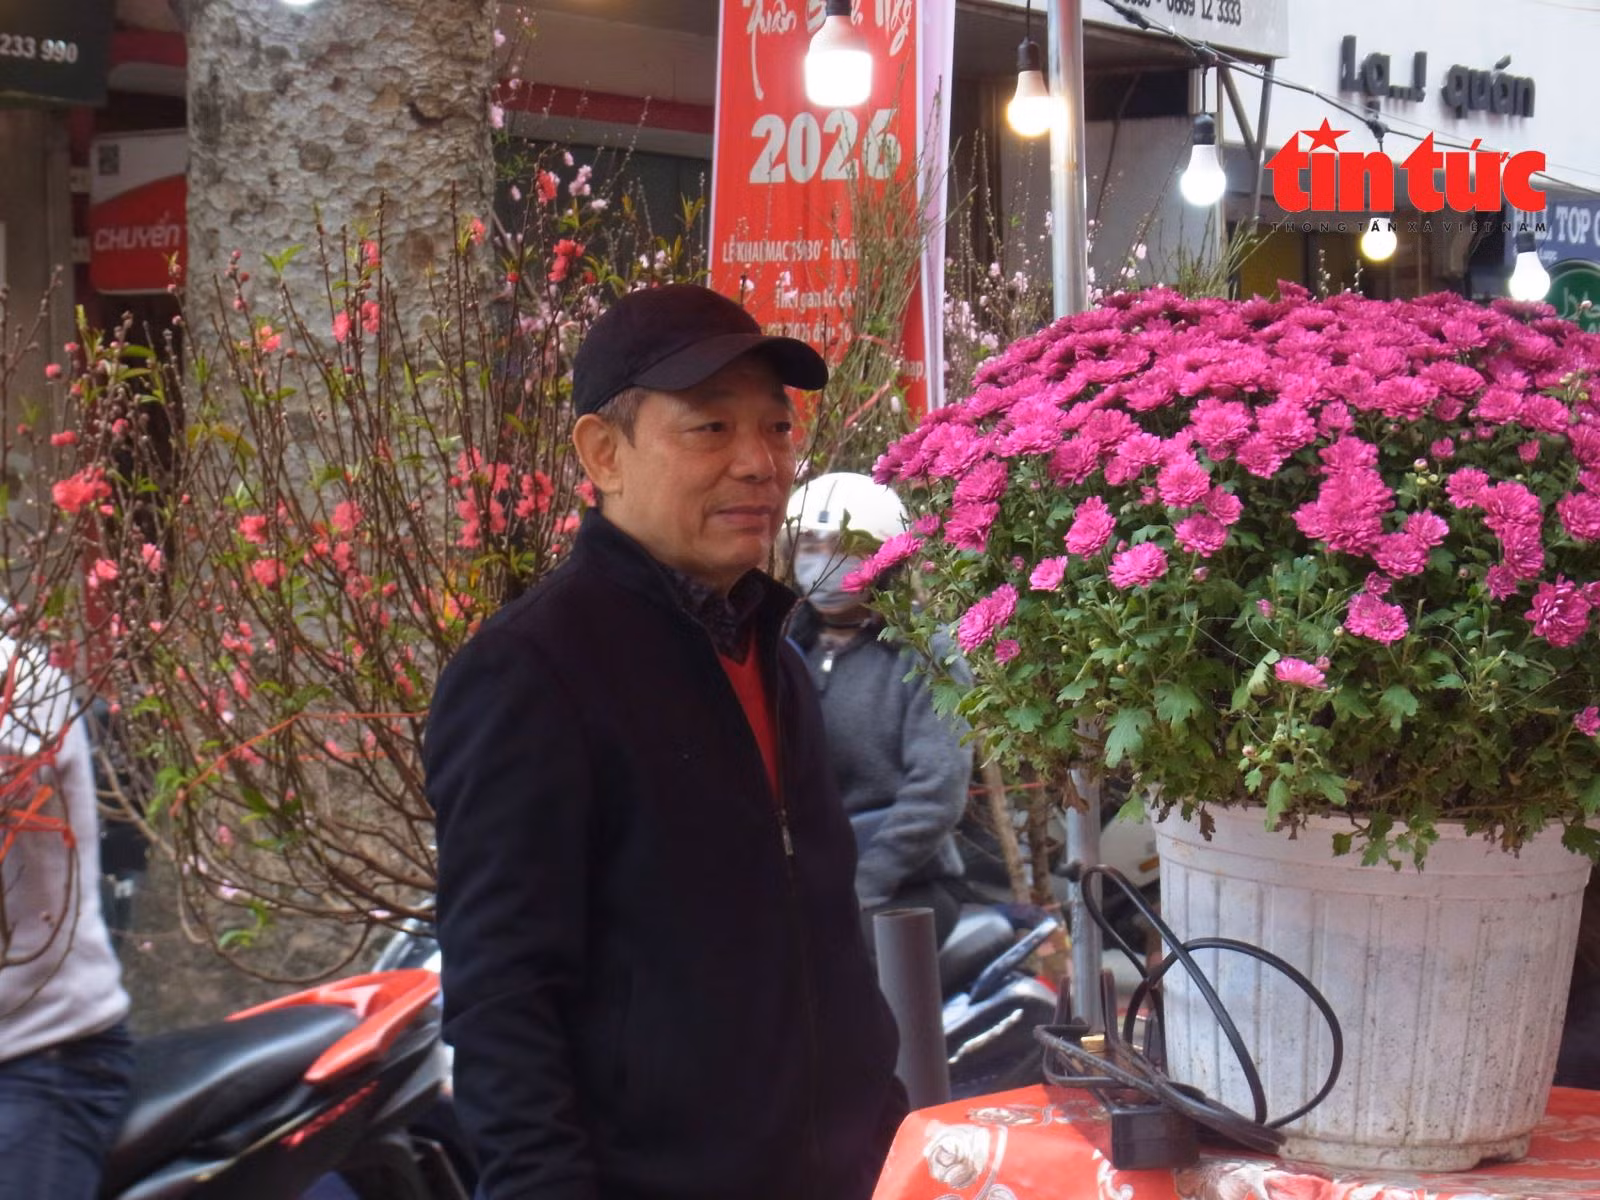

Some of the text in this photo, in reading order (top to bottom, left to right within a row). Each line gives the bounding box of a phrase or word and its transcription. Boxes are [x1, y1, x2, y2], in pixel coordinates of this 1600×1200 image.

[1217, 0, 1242, 26] 3333
[41, 39, 79, 64] 990
[1442, 55, 1535, 118] quán
[750, 109, 902, 183] 2026
[1555, 205, 1591, 244] TOP
